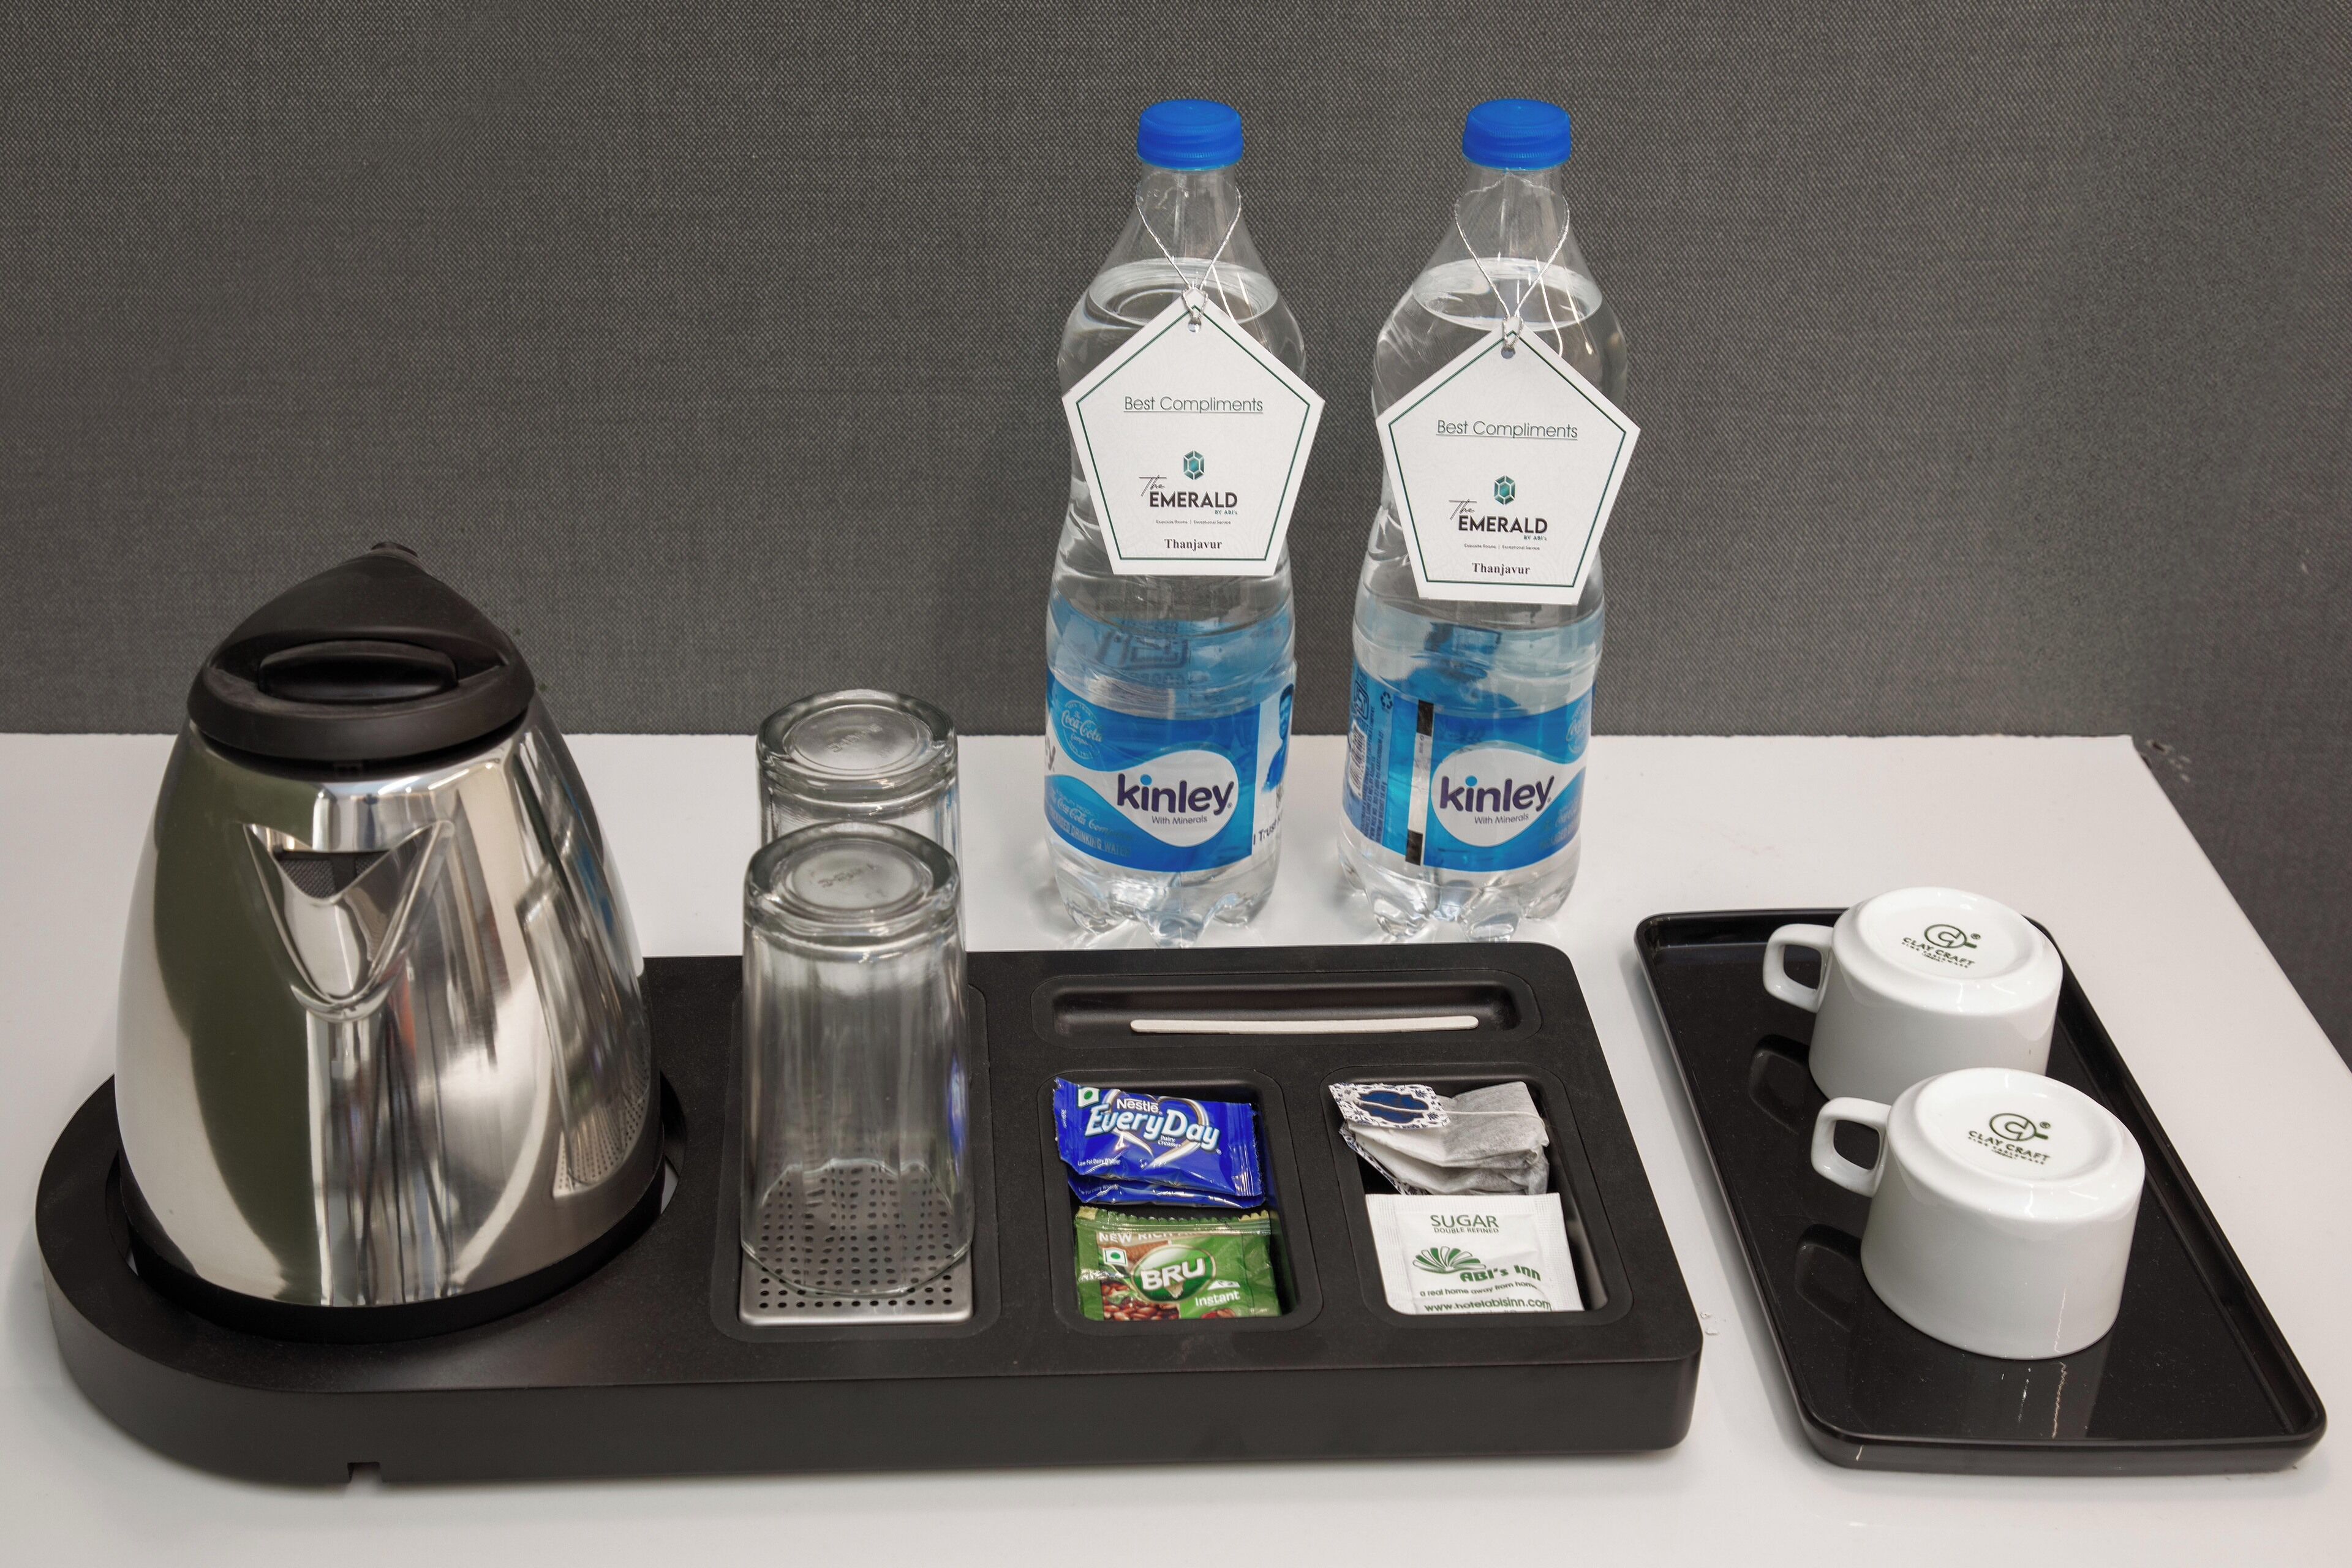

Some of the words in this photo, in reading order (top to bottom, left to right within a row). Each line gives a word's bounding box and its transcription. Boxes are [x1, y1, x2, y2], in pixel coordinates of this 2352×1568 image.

[1125, 396, 1155, 410] Best
[1160, 396, 1263, 413] Compliments
[1438, 420, 1468, 434] Best
[1472, 420, 1578, 439] Compliments
[1139, 475, 1167, 497] The
[1150, 491, 1238, 508] EMERALD
[1449, 499, 1477, 521] The
[1458, 515, 1548, 533] EMERALD
[1164, 538, 1223, 551] Thanjavur
[1471, 562, 1531, 576] Thanjavur
[1117, 773, 1234, 816] kinley
[1440, 775, 1555, 812] kinley
[1152, 815, 1170, 824] With
[1172, 815, 1208, 825] Minerals
[1474, 815, 1493, 824] With
[1494, 813, 1529, 824] Minerals
[1070, 824, 1102, 851] DRINKING
[1903, 937, 1934, 951] CLAY
[1935, 949, 1975, 965] CRAFT
[1969, 1131, 2003, 1146] CLAY
[2005, 1144, 2051, 1161] CRAFT
[1430, 1214, 1499, 1228] SUGAR
[1099, 1232, 1132, 1245] NEW
[1140, 1257, 1205, 1291] BRU
[1195, 1291, 1240, 1306] Instant
[1428, 1288, 1444, 1297] real
